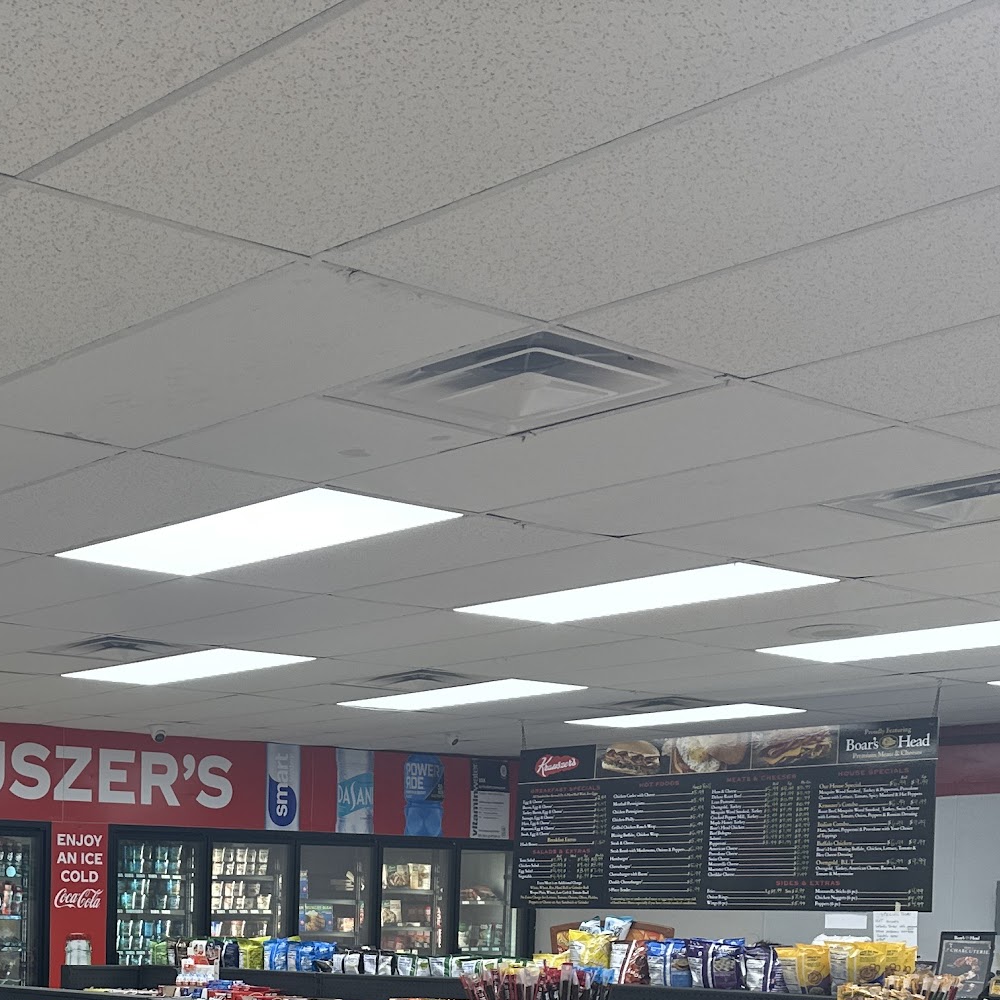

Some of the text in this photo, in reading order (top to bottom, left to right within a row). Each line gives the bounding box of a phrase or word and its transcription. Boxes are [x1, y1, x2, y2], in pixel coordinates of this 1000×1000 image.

[846, 733, 930, 752] Boar's Head
[405, 763, 440, 777] POWER
[275, 753, 290, 818] smart
[57, 834, 102, 847] ENJOY
[57, 852, 103, 865] AN ICE
[60, 870, 99, 883] COLD
[54, 888, 104, 909] Coca-Cola
